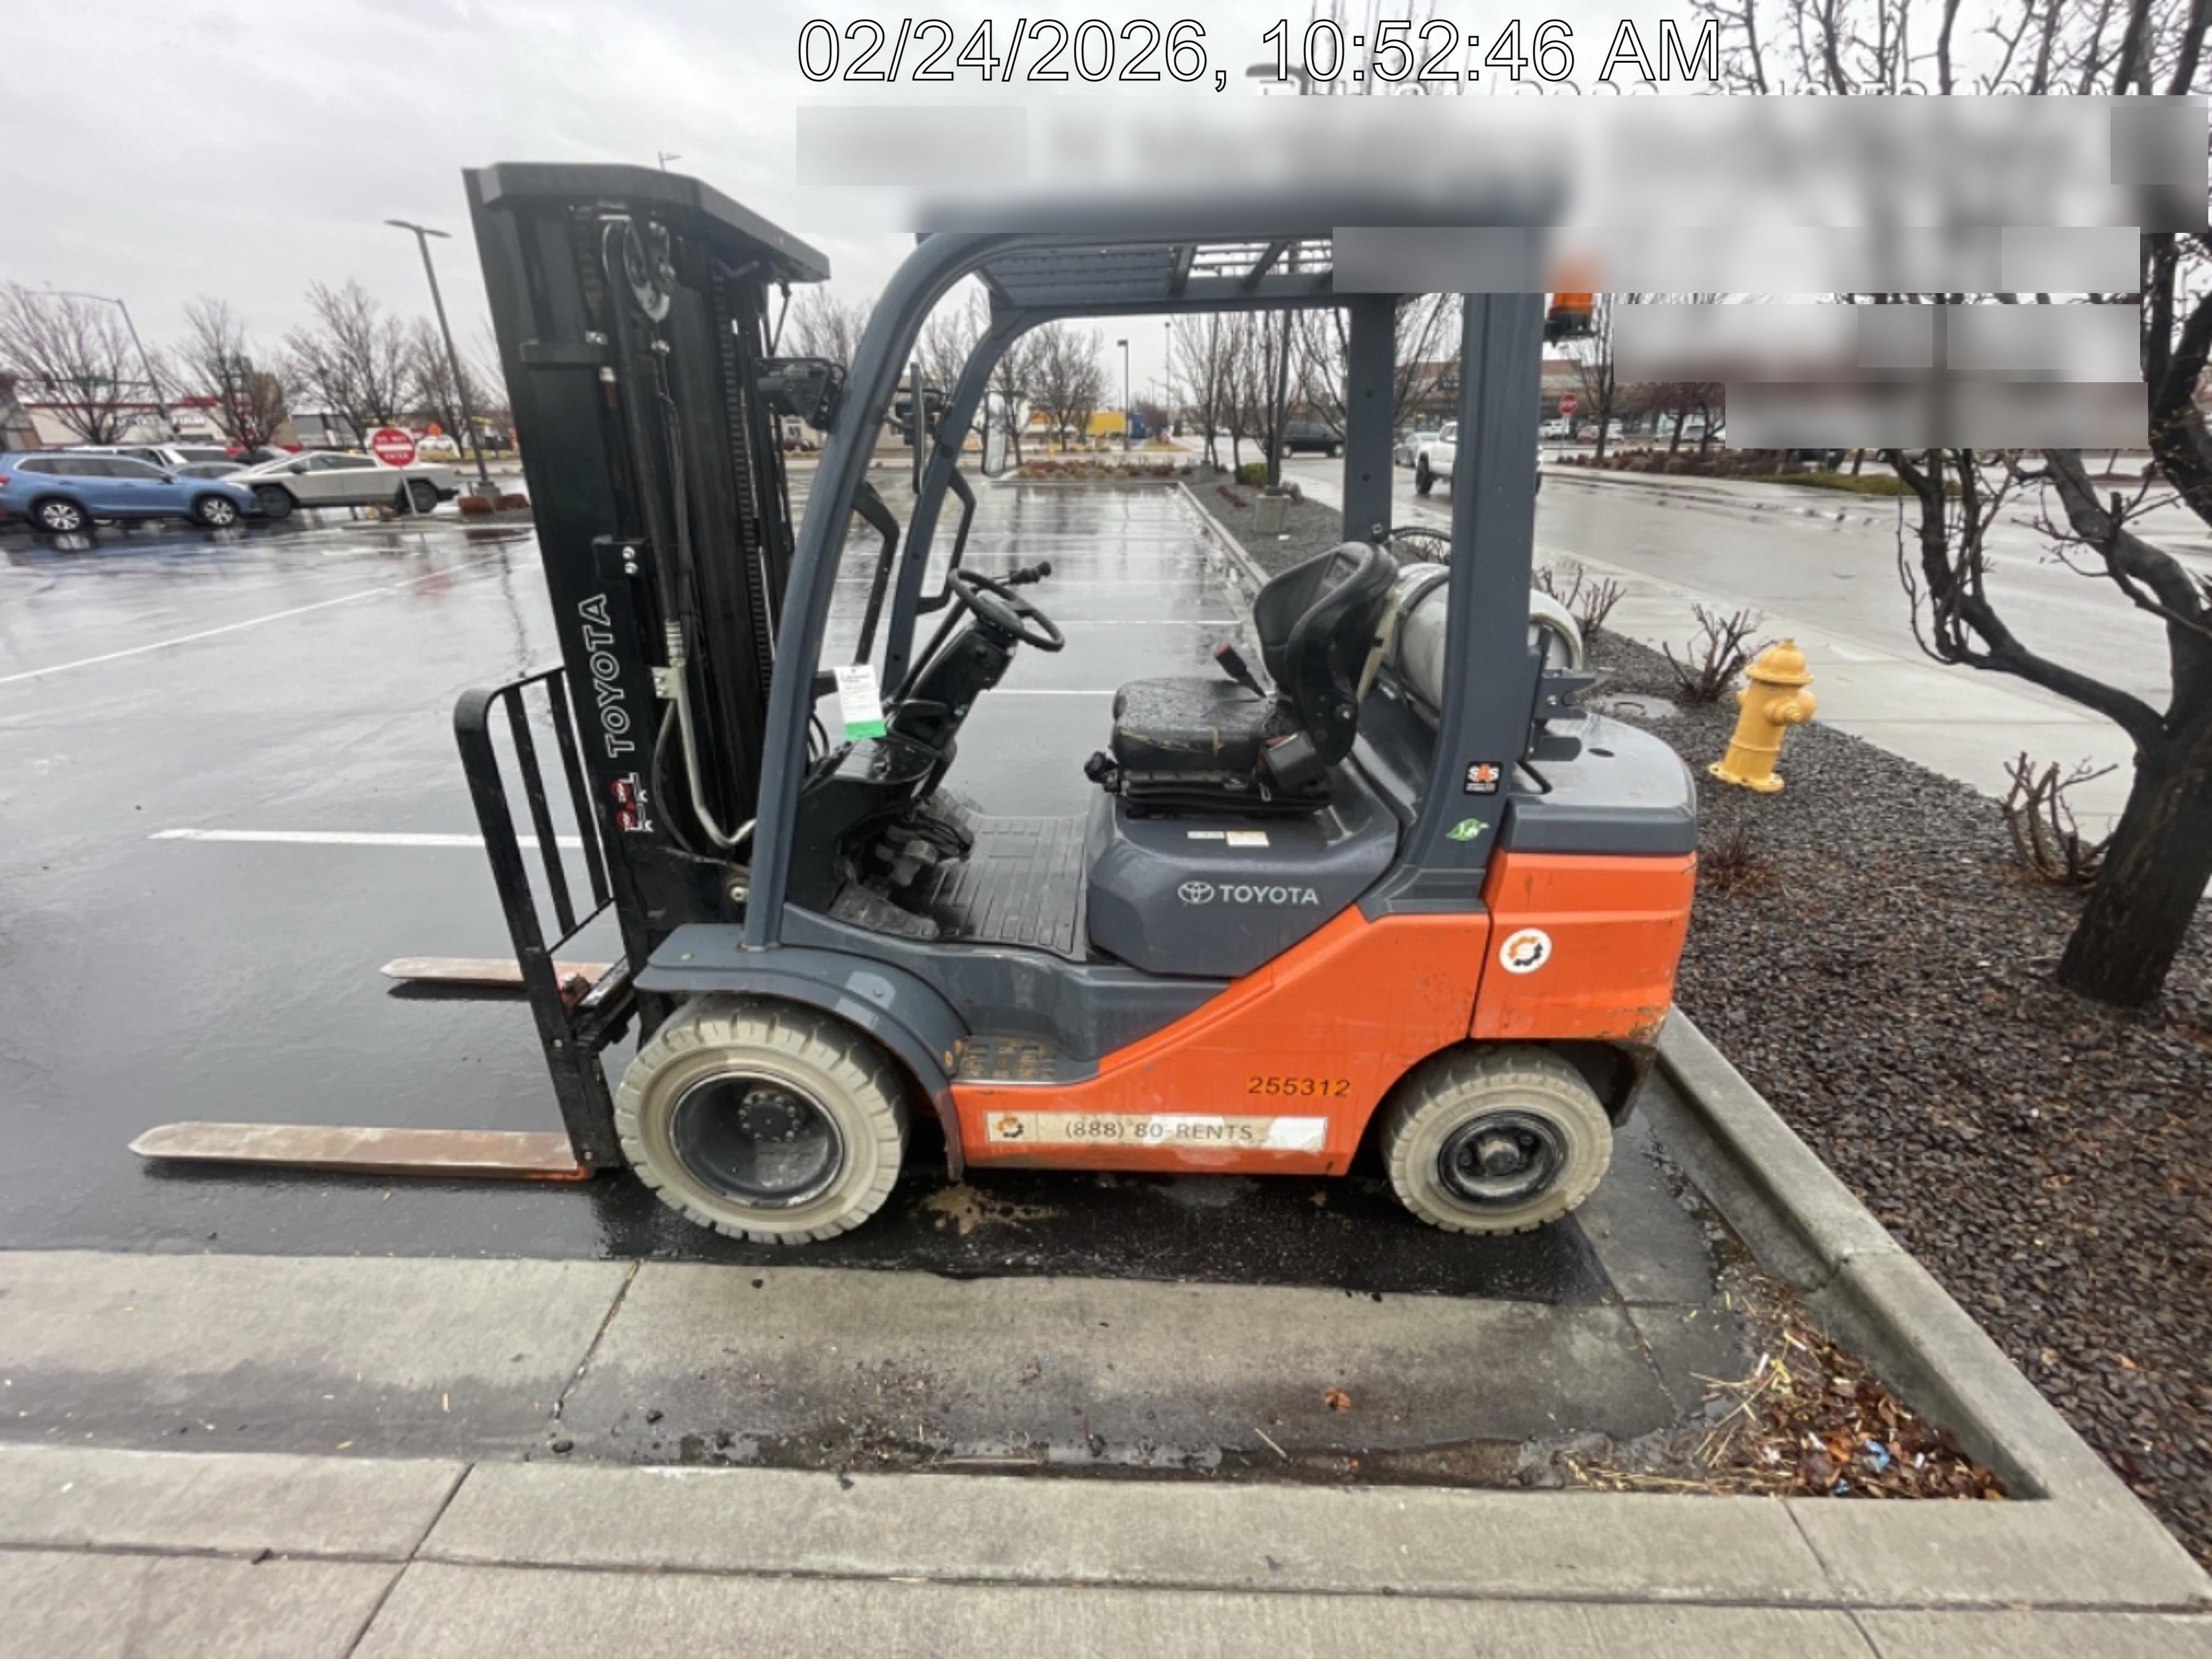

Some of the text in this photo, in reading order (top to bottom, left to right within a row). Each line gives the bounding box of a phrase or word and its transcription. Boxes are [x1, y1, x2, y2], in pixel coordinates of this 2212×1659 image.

[578, 592, 635, 758] TOYOTA
[1218, 884, 1319, 905] TOYOTA
[1247, 1076, 1352, 1097] 255312
[1065, 1120, 1124, 1139] (888)
